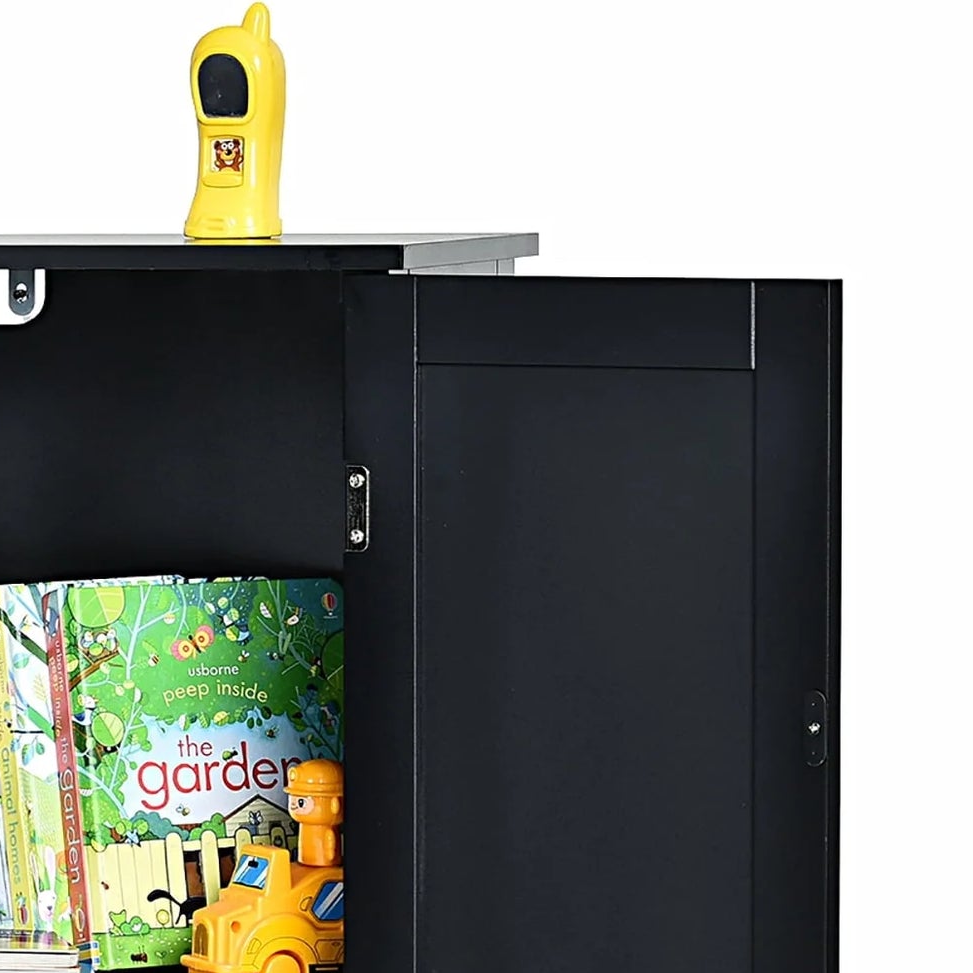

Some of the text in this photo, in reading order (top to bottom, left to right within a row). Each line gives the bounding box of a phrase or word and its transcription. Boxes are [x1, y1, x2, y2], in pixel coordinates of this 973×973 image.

[54, 640, 65, 692] usborne
[187, 662, 240, 678] usborne
[163, 679, 269, 707] peep inside
[49, 656, 81, 884] peep inside the garden
[177, 735, 213, 758] the
[1, 747, 17, 815] animal
[8, 821, 21, 885] homes
